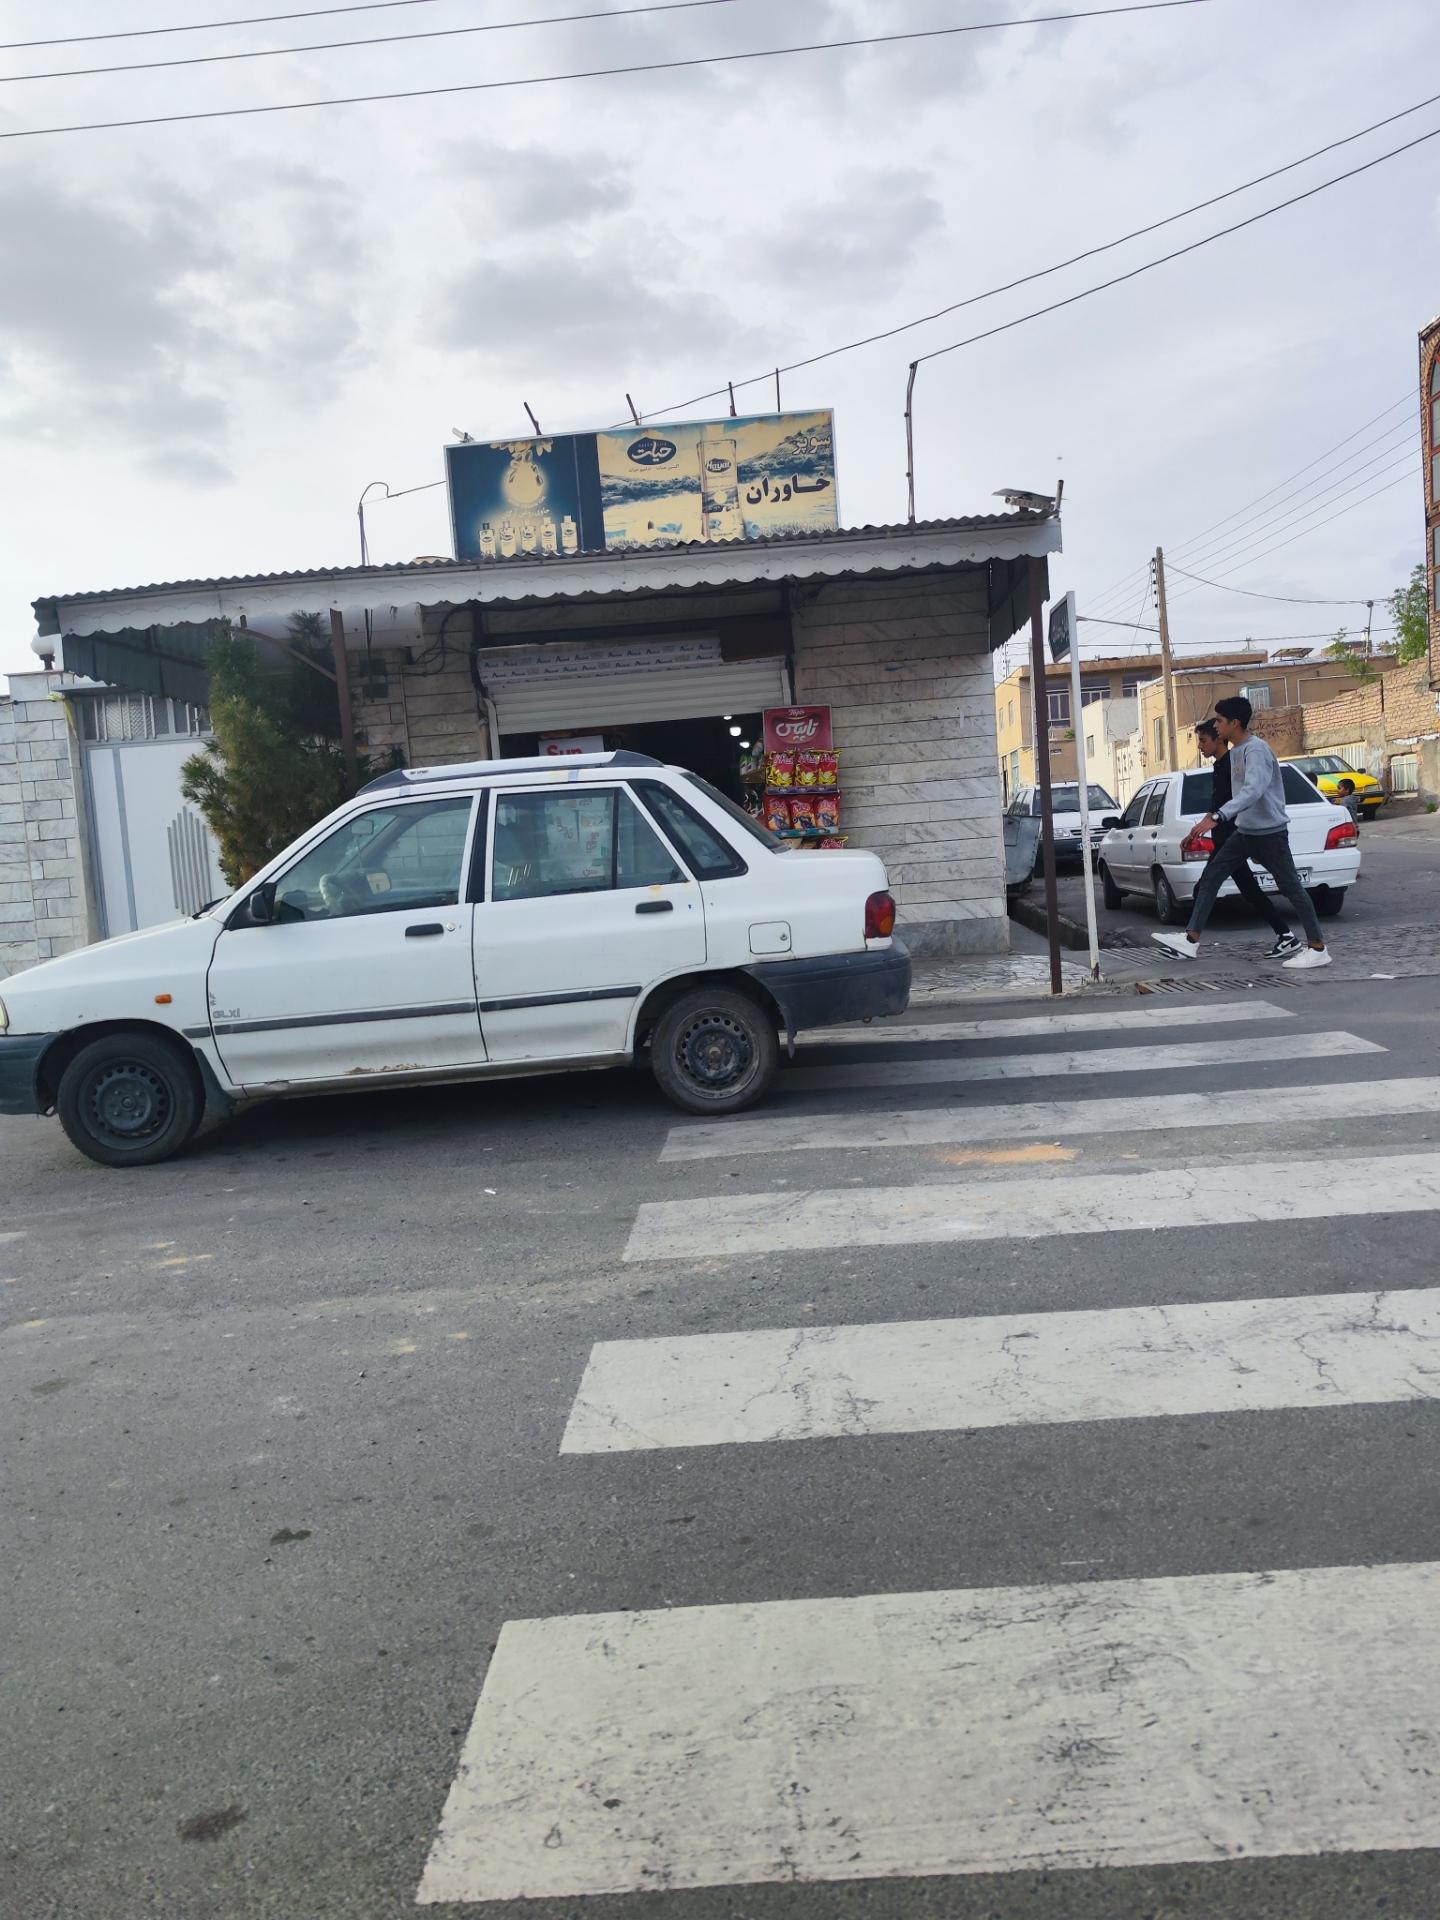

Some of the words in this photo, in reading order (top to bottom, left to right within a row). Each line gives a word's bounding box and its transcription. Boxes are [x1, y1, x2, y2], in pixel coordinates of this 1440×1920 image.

[631, 440, 673, 462] حیات
[791, 434, 832, 456] سوپر
[746, 472, 831, 504] خاوران
